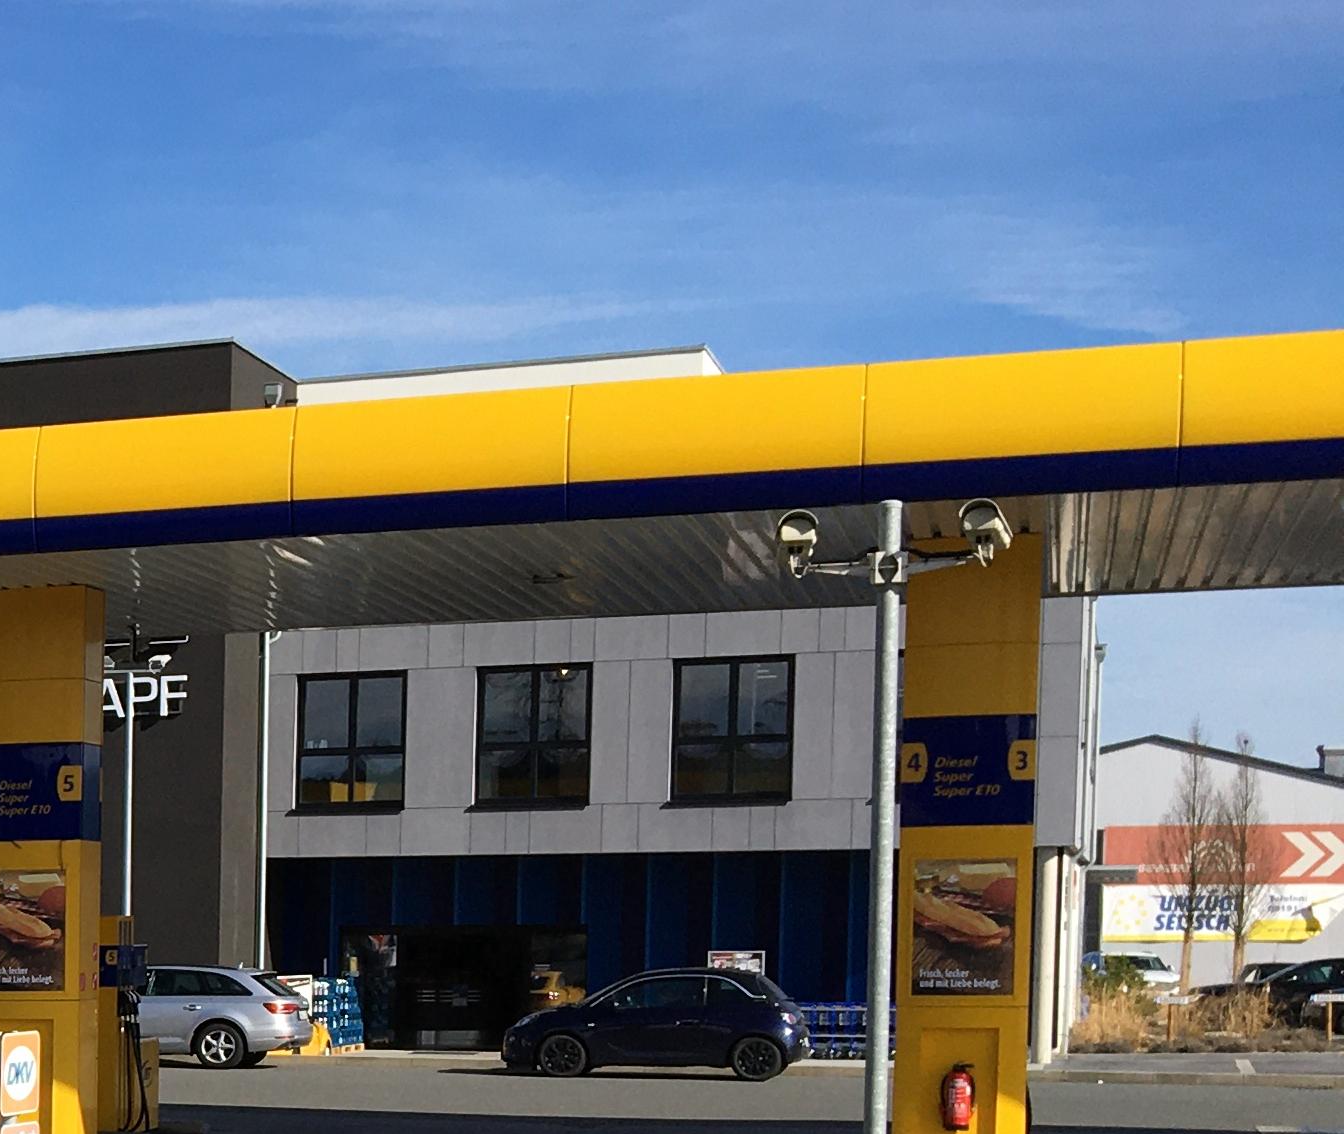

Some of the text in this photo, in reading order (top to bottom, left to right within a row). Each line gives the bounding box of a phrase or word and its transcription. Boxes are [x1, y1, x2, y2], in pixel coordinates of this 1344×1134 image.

[907, 752, 922, 772] 4
[934, 755, 978, 769] Diesel
[1015, 750, 1028, 770] 3
[62, 774, 74, 793] 5
[934, 771, 974, 786] Super
[933, 784, 1001, 798] Super E10
[31, 804, 51, 815] E10
[1153, 913, 1231, 931] SELSCH
[944, 968, 970, 978] lecker
[919, 979, 934, 988] und
[950, 978, 972, 988] Liebe
[973, 978, 1002, 990] belegt.
[6, 1060, 34, 1086] DKV
